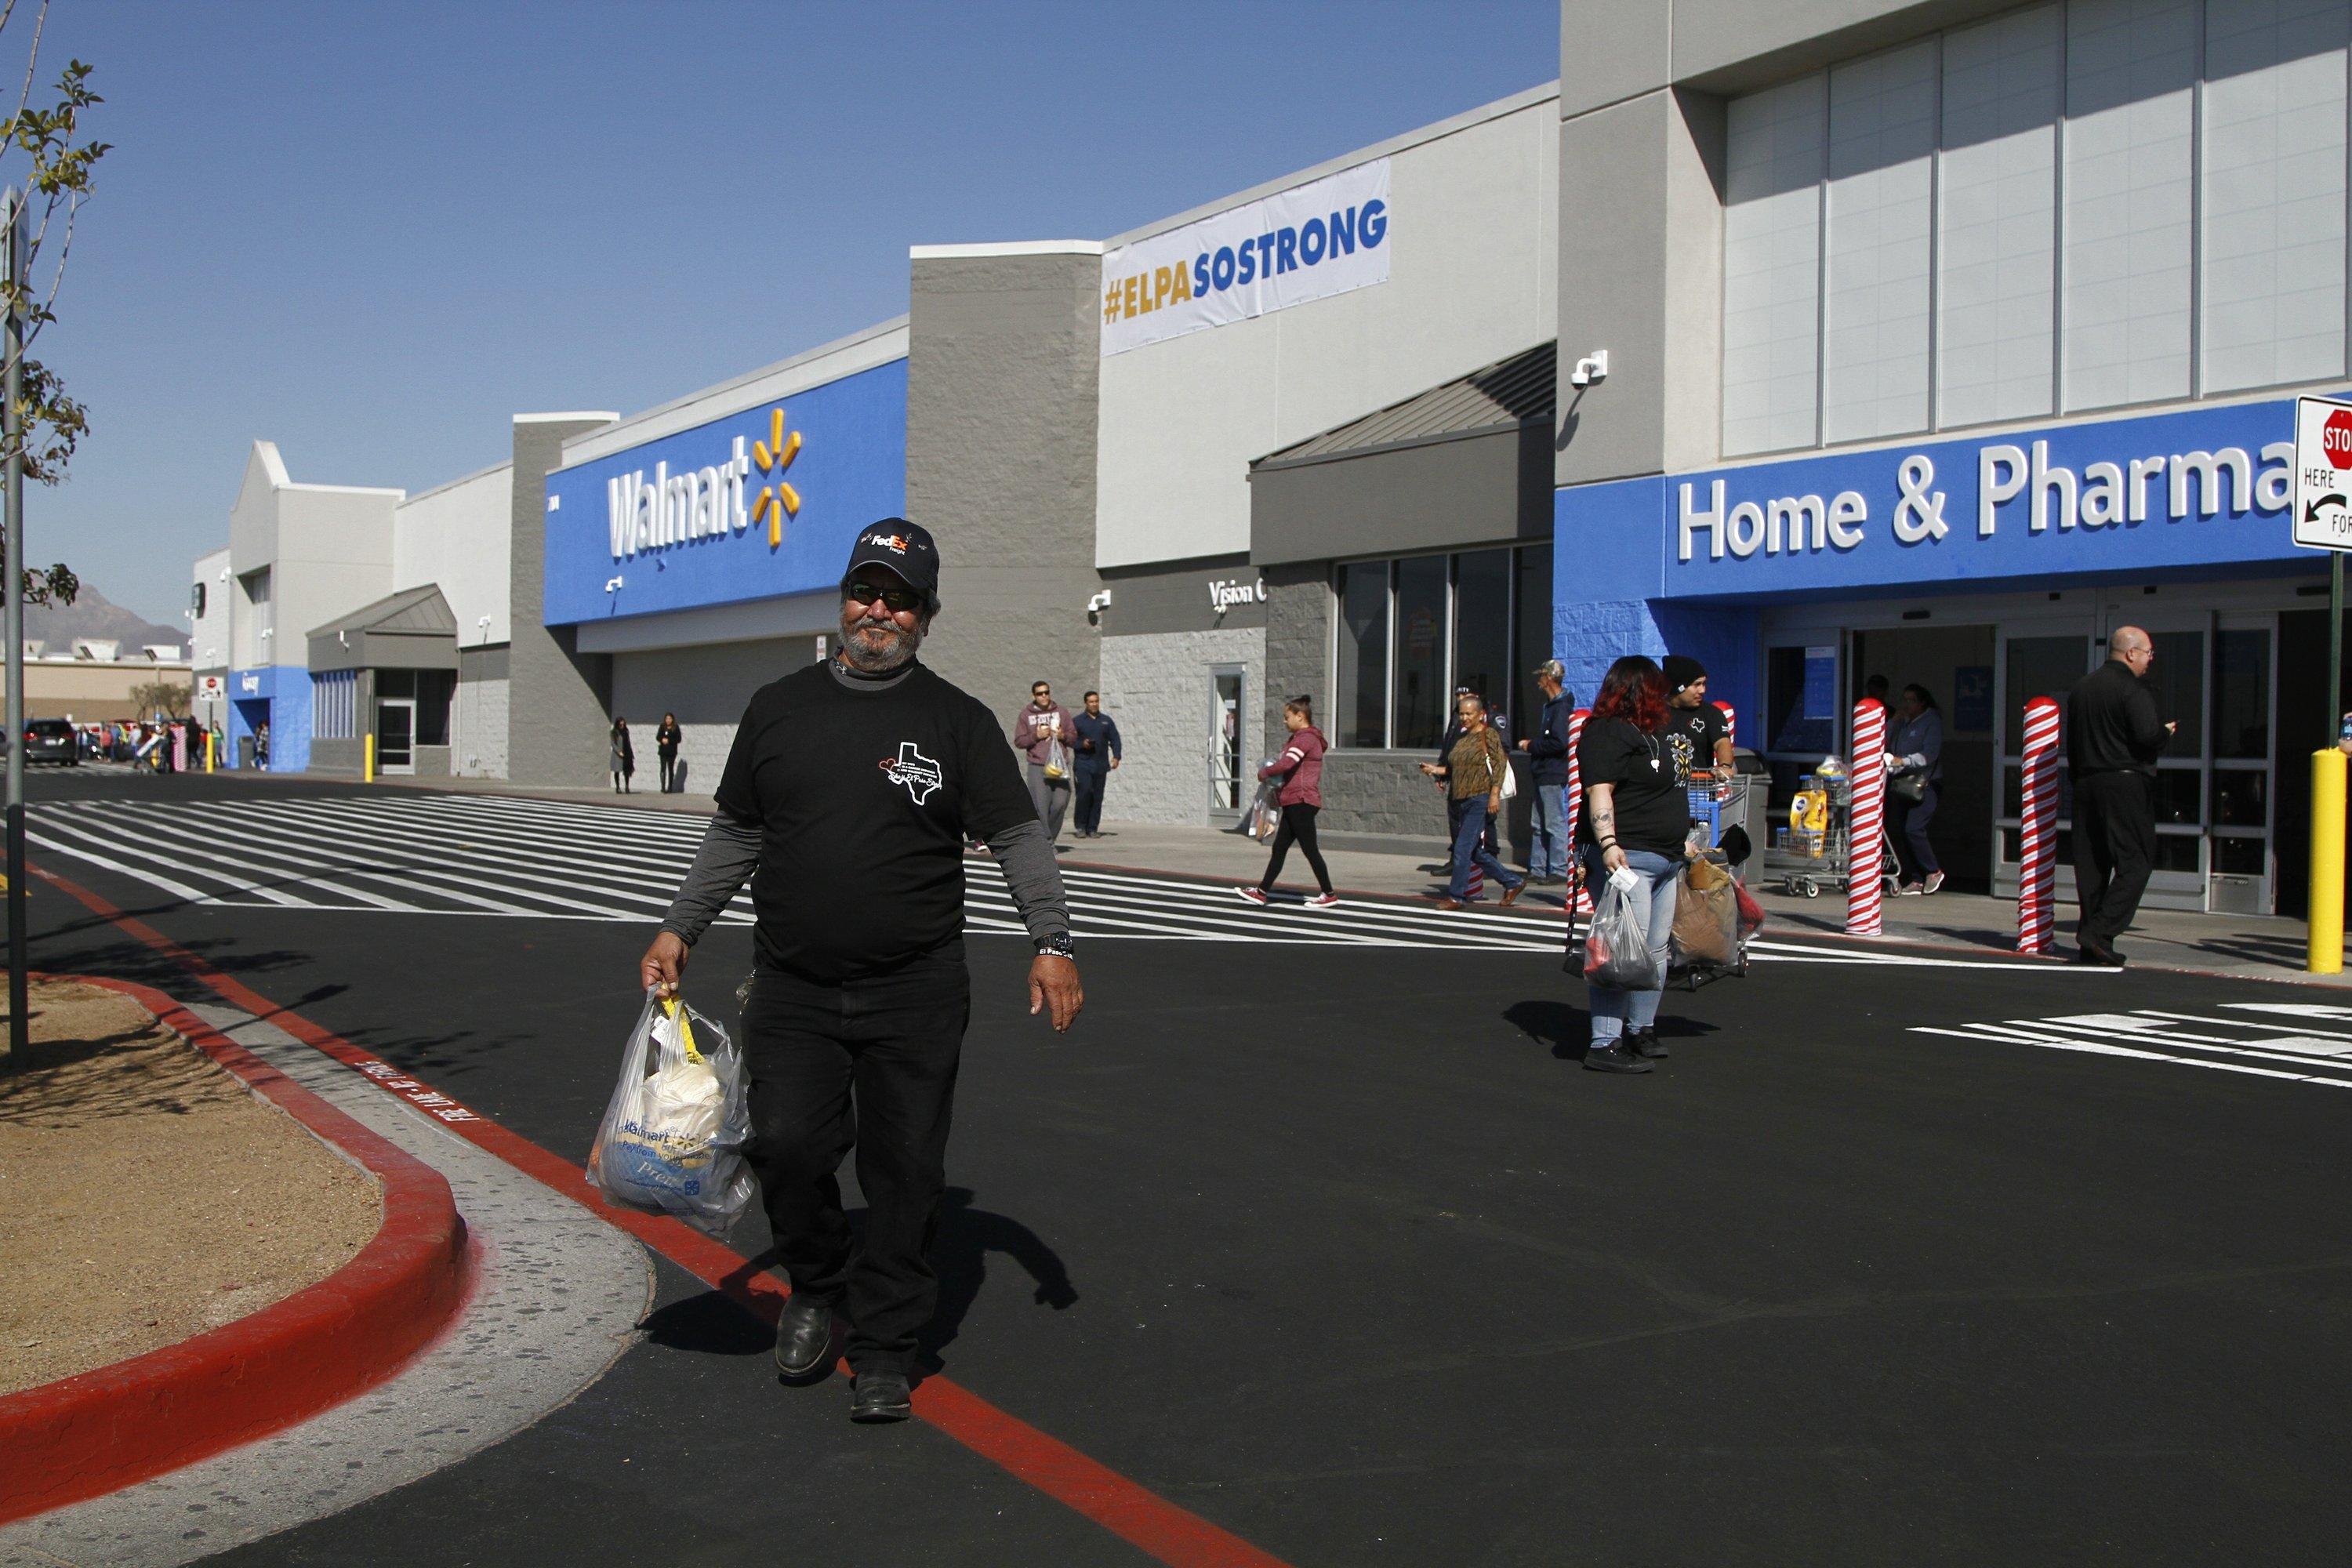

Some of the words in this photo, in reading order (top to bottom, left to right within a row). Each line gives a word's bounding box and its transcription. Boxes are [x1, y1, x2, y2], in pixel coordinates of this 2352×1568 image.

[1104, 198, 1388, 325] #ELPASOSTRONG
[2325, 428, 2352, 452] STO
[2305, 467, 2335, 488] HERE
[608, 436, 749, 558] Walmart
[1678, 479, 1867, 561] Home
[1893, 455, 1950, 544] &
[1978, 440, 2296, 535] Pharma
[871, 535, 908, 550] FedEx
[889, 546, 906, 555] Freight
[1208, 579, 1253, 606] Vision
[433, 1108, 481, 1121] FIRE
[624, 1119, 670, 1143] Walmart
[622, 1140, 634, 1152] Pay
[636, 1145, 656, 1158] from
